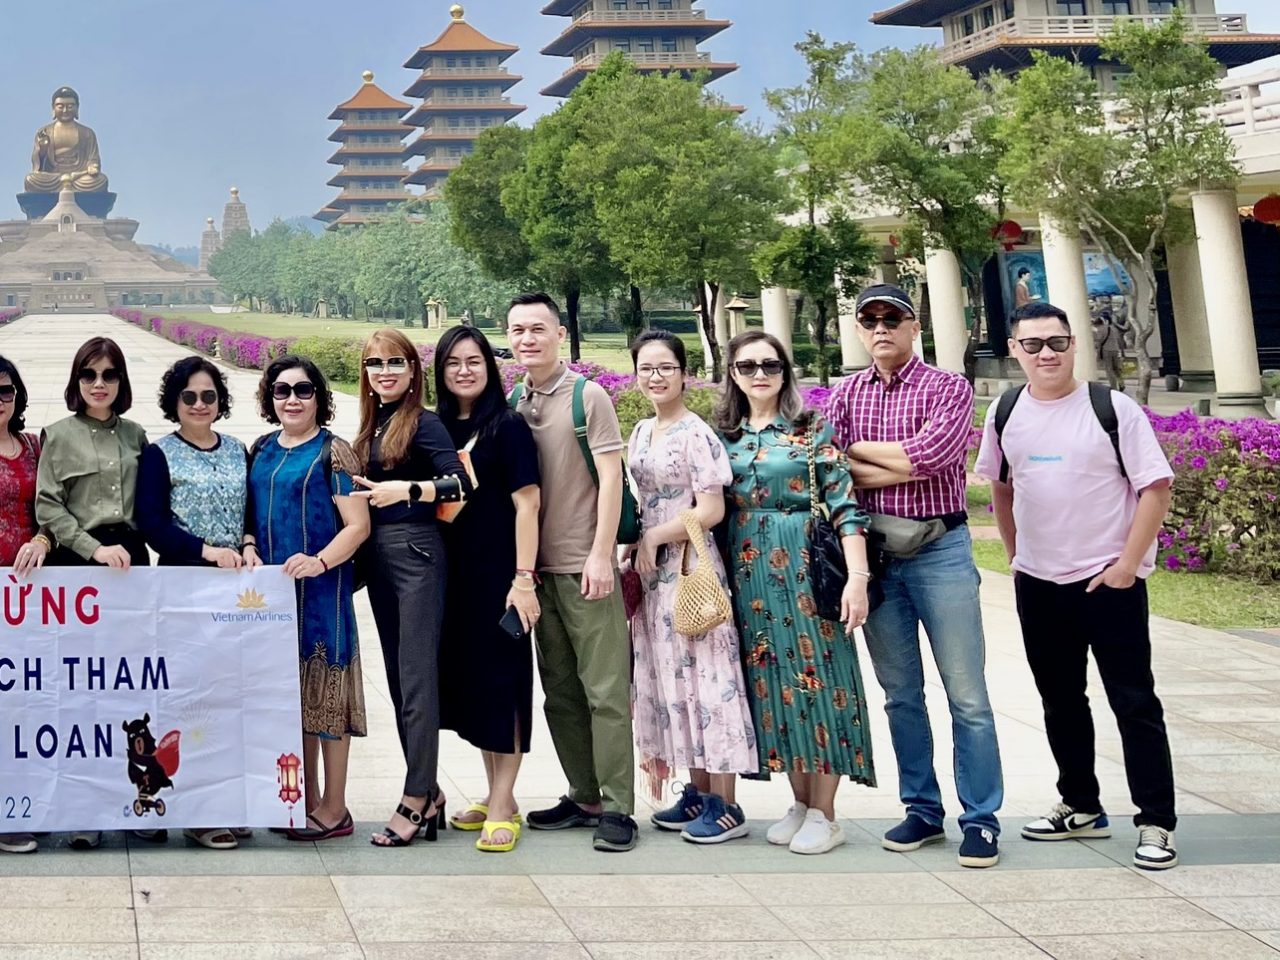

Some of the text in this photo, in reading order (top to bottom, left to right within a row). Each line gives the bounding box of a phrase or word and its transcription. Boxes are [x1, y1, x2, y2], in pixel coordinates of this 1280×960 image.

[211, 611, 293, 622] Vietnam Airlines
[62, 656, 170, 691] THAM
[14, 723, 113, 759] LOAN
